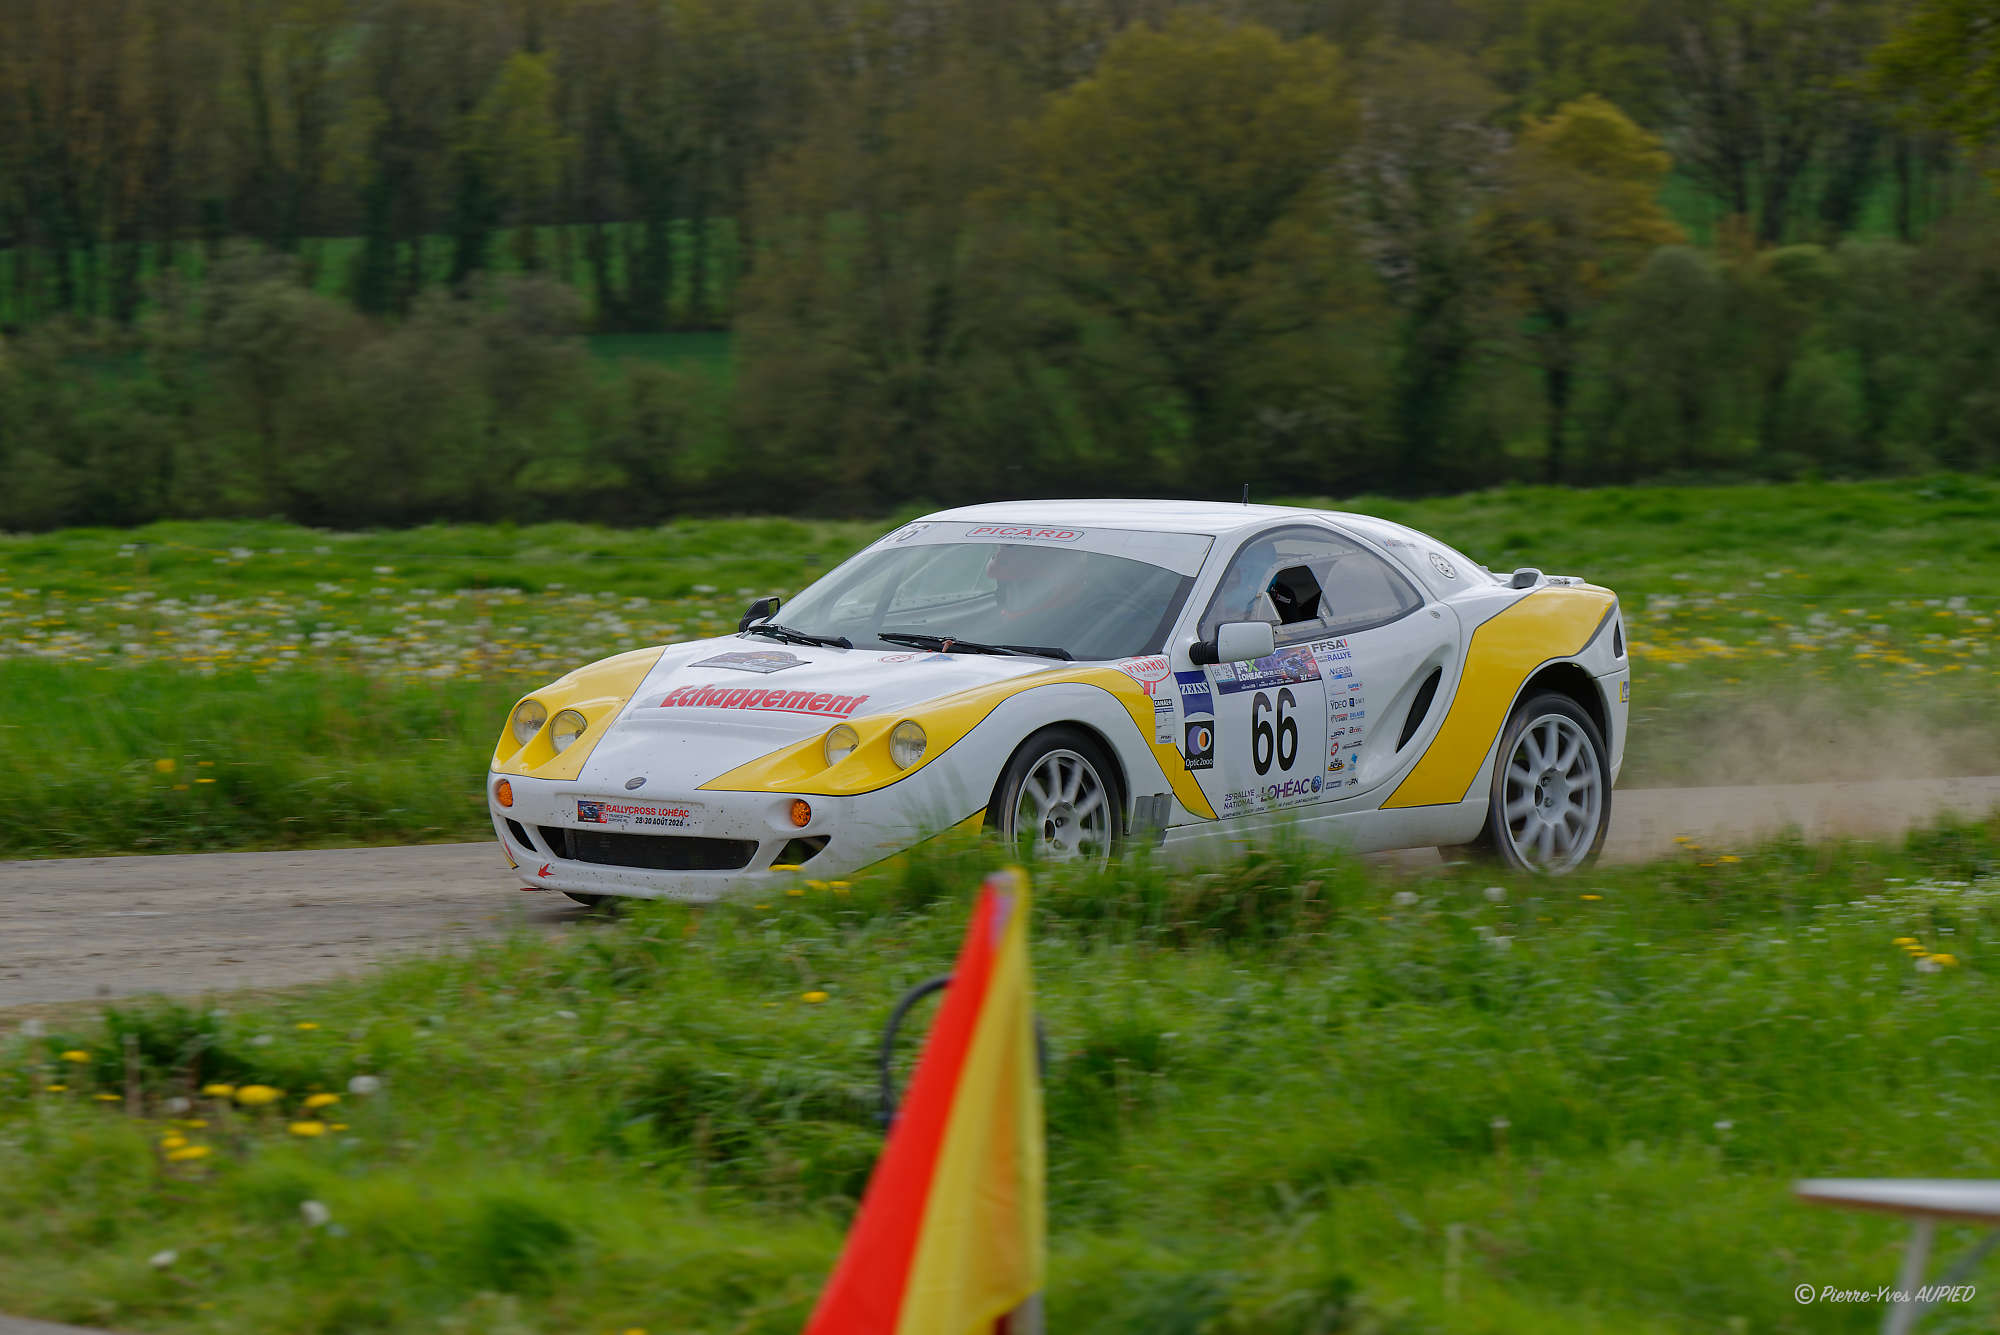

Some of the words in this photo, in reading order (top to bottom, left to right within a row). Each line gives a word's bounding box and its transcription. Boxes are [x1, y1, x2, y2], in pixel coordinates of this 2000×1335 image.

[972, 527, 1075, 540] PICARD
[1311, 639, 1346, 653] FFSA
[1327, 651, 1352, 662] RALLYE
[1126, 657, 1166, 674] PICARD
[1180, 682, 1210, 695] ZEISS
[1251, 687, 1299, 776] 66
[1233, 788, 1255, 800] RALLYE
[1223, 799, 1254, 810] NATIONAL
[606, 805, 656, 816] RALLYCROSS
[658, 808, 690, 818] LOHÉAC
[668, 819, 684, 827] 2026
